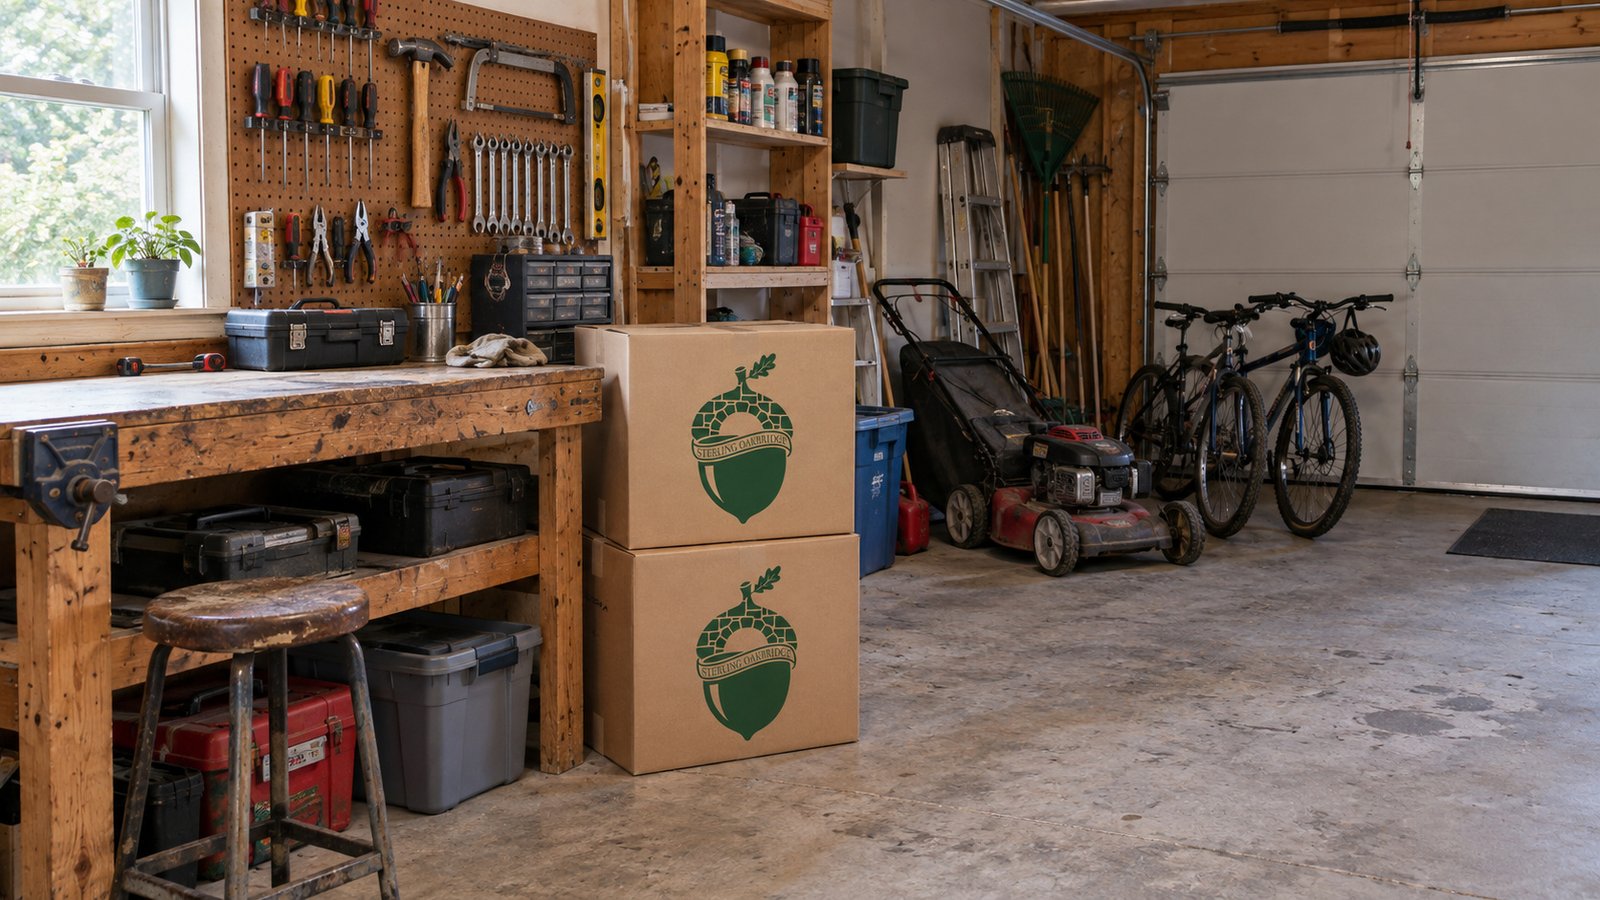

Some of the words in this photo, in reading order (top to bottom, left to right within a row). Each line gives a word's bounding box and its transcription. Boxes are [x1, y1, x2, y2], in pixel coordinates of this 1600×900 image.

[697, 443, 738, 458] STERLING
[701, 660, 742, 677] STERLING
[743, 648, 791, 664] OAKBRIDGE
